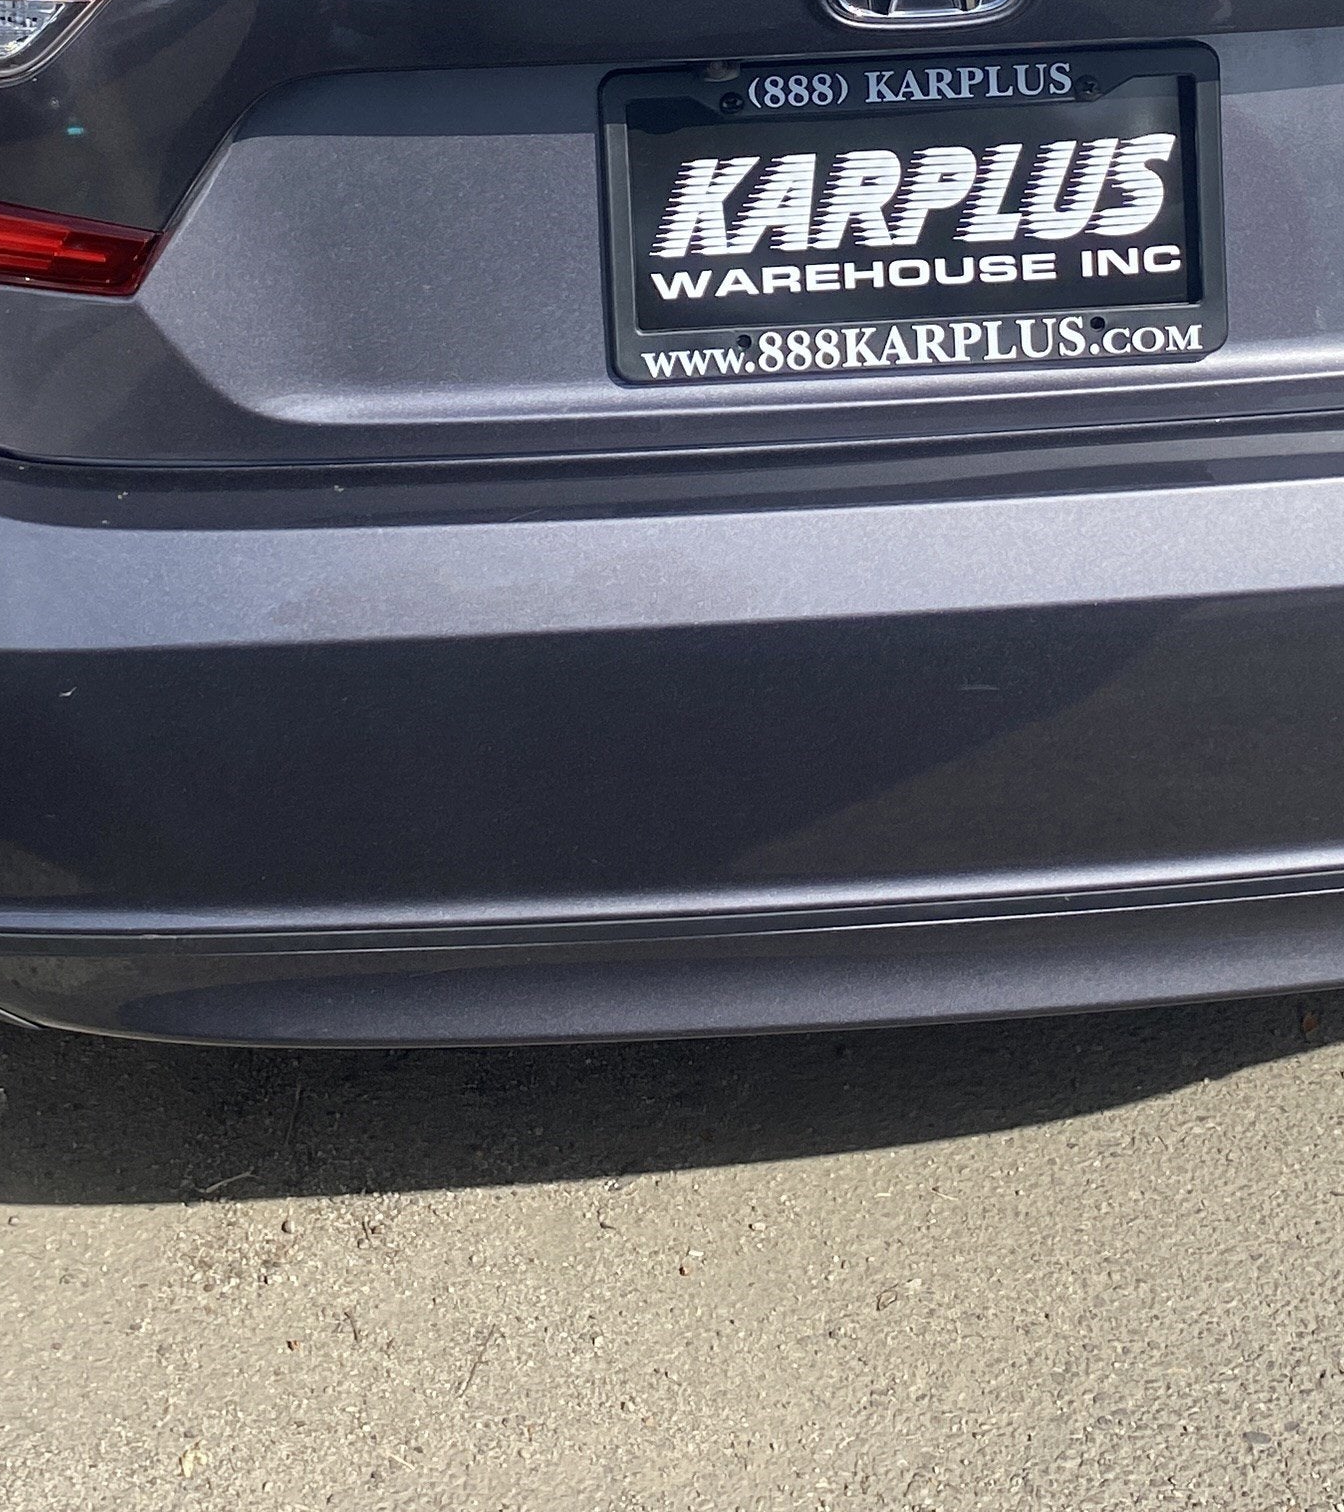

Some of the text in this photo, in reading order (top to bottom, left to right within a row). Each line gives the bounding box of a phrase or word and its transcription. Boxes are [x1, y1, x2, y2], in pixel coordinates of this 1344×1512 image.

[748, 63, 1072, 109] (888) KARPLUS
[649, 132, 1177, 258] KARPLUS
[651, 245, 1182, 301] WAREHOUSE INC
